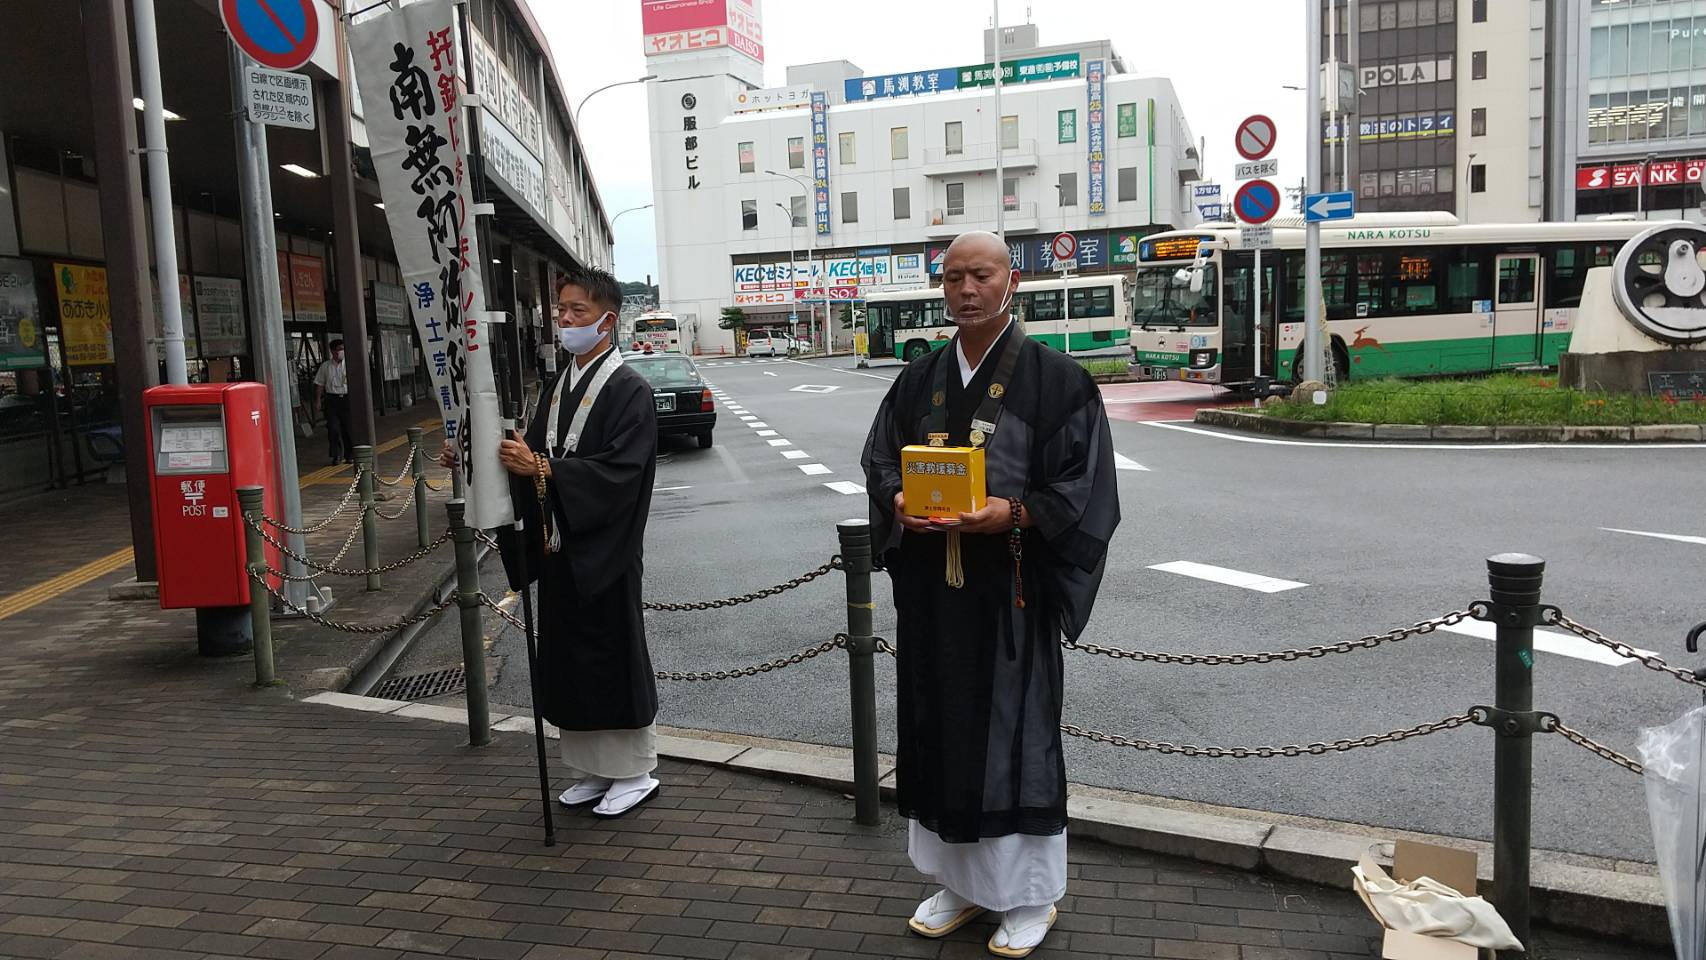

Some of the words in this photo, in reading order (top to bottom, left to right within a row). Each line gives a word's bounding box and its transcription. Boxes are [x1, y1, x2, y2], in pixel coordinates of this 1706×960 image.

[652, 29, 720, 51] ヤオヒコ
[734, 32, 759, 57] DAISO
[1364, 66, 1425, 85] POLA
[252, 88, 309, 106] された区域内の
[752, 89, 809, 104] ホットヨガ
[287, 110, 310, 124] を除く
[683, 116, 701, 190] 服部ビル
[1237, 164, 1276, 177] バスを除く
[1347, 230, 1386, 240] NARA
[1388, 229, 1431, 239] KOTSU
[747, 293, 785, 303] ヤオヒコ
[906, 461, 968, 476] 災害救援募金
[180, 480, 206, 494] 郵便
[182, 504, 207, 517] POST
